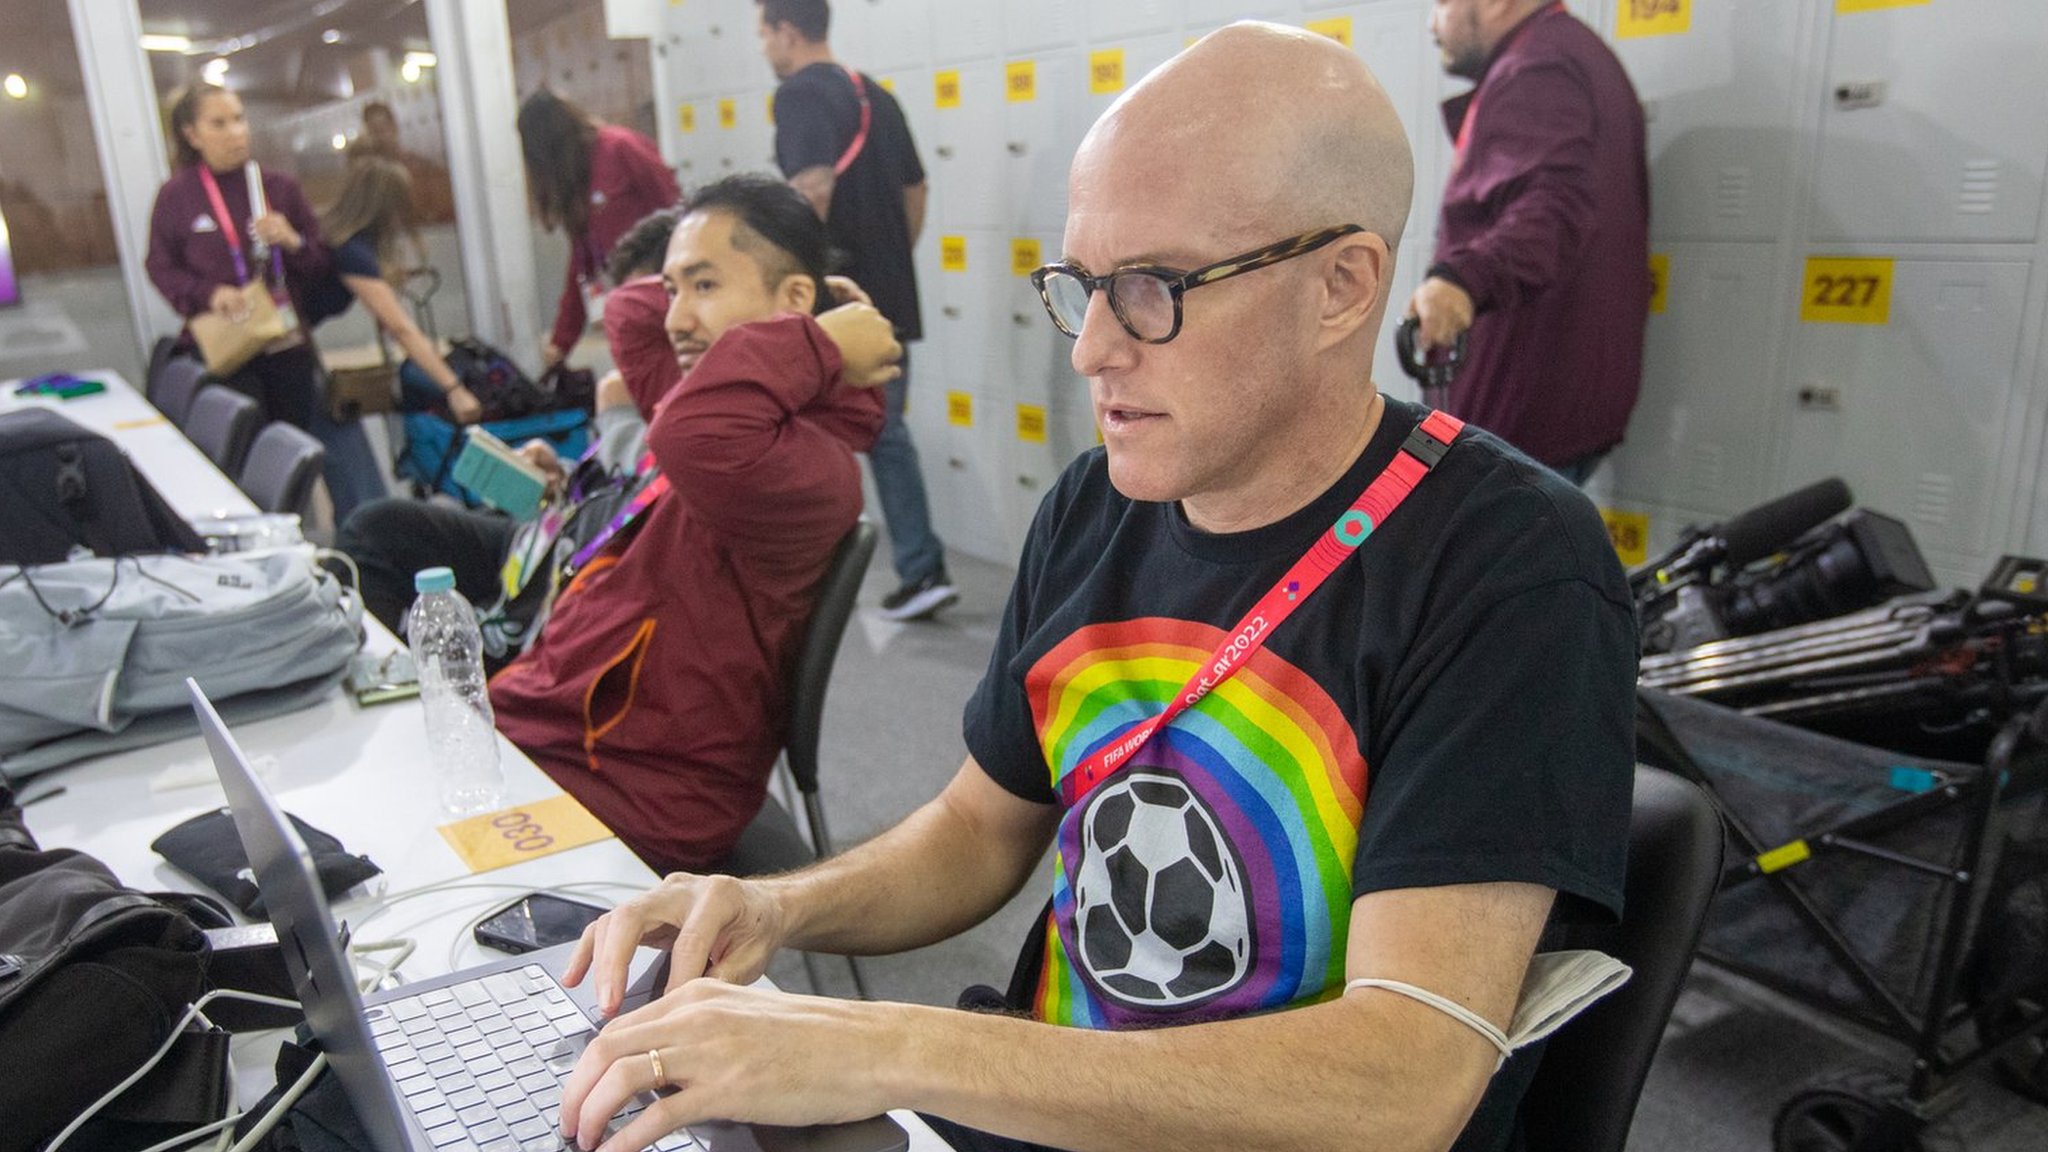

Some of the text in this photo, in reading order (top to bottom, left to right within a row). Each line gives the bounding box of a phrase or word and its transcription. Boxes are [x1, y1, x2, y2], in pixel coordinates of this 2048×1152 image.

[1814, 274, 1880, 306] 227
[1104, 745, 1125, 768] FIFA
[492, 812, 555, 852] 030
